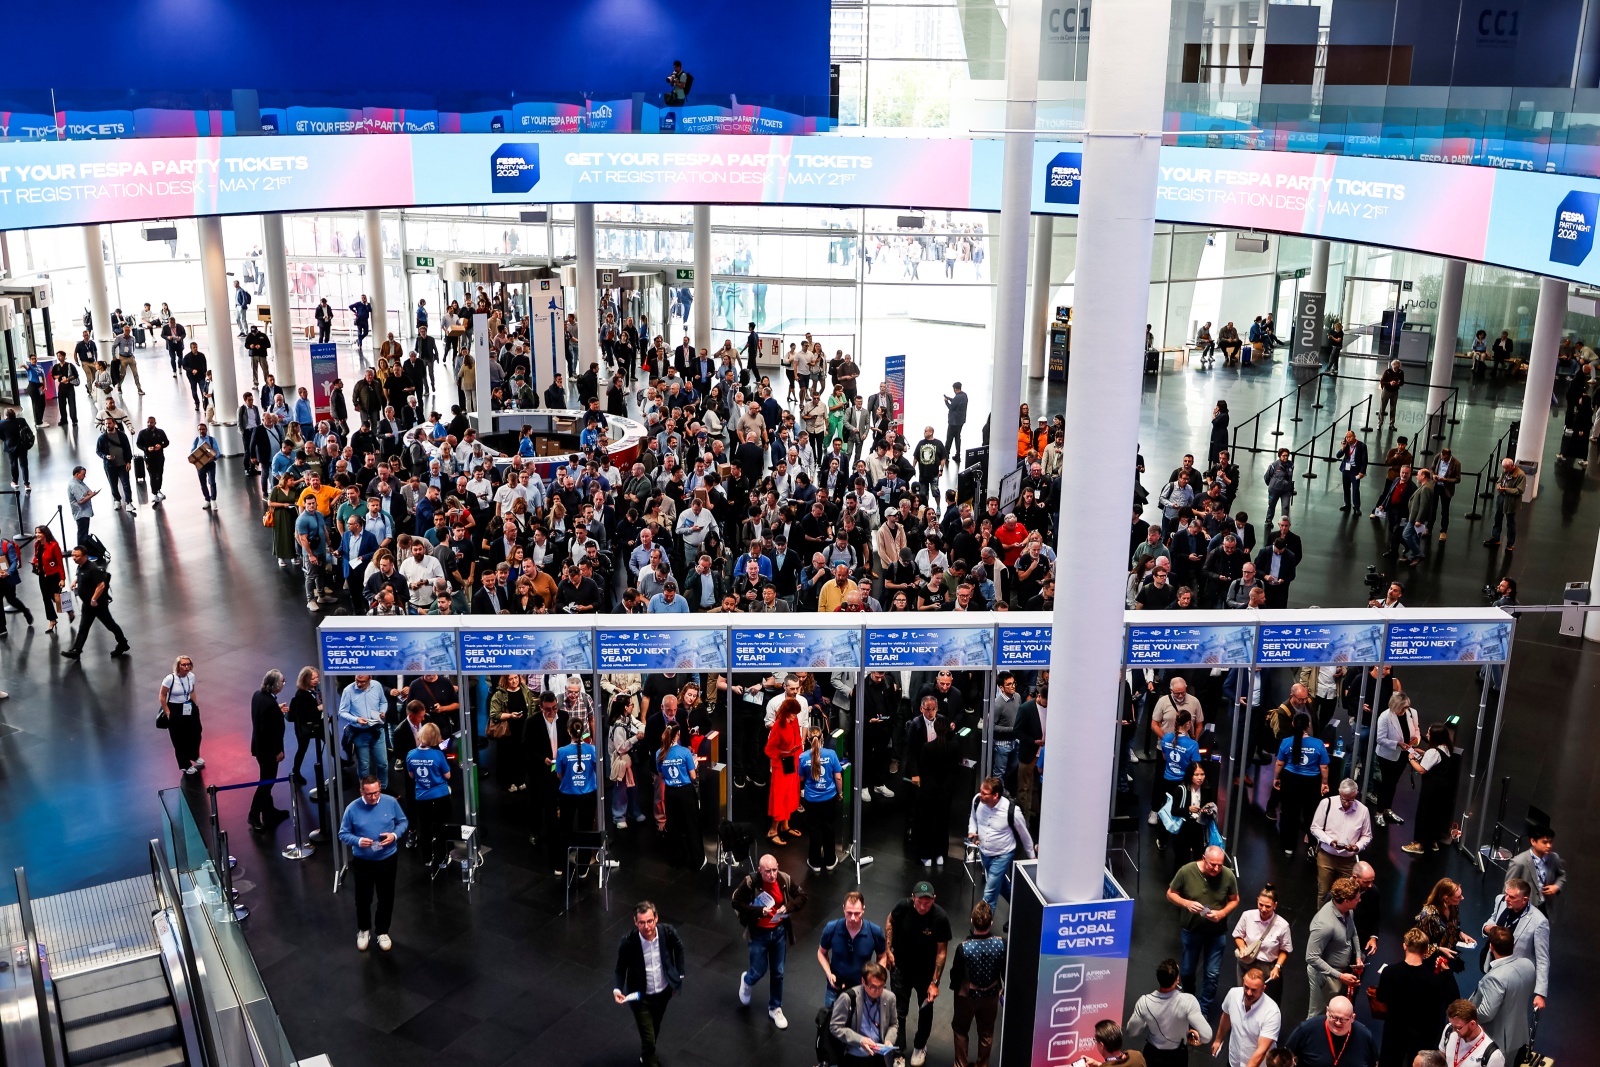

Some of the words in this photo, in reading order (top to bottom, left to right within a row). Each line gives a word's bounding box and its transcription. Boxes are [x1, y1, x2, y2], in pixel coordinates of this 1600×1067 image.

[1049, 8, 1090, 32] CC1
[1478, 9, 1518, 36] CC1
[296, 120, 308, 132] GET
[310, 121, 334, 132] YOUR
[531, 116, 547, 126] YOUR
[548, 116, 566, 126] FESPA
[760, 118, 783, 128] TICKETS
[68, 124, 124, 134] TICKETS
[564, 152, 604, 166] GET
[607, 152, 660, 166] YOUR
[663, 153, 724, 166] FESPA
[728, 154, 791, 167] PARTY
[795, 154, 872, 168] TICKETS
[1488, 156, 1534, 170] TICKETS
[15, 164, 76, 182] YOUR
[80, 162, 148, 179] FESPA
[152, 159, 220, 176] PARTY
[225, 156, 308, 172] TICKETS
[1052, 166, 1080, 174] FESPA
[579, 170, 602, 182] AT
[606, 170, 726, 184] REGISTRATION
[730, 172, 774, 184] DESK
[788, 172, 826, 184] MAY
[1160, 166, 1212, 183] YOUR
[1215, 170, 1272, 187] FESPA
[1276, 174, 1332, 192] PARTY
[1336, 178, 1405, 200] TICKETS
[16, 182, 152, 204] REGISTRATION
[156, 180, 205, 196] DESK
[220, 177, 259, 192] MAY
[1157, 186, 1272, 208] REGISTRATION
[1276, 195, 1315, 212] DESK
[1327, 200, 1361, 217] MAY
[1561, 211, 1585, 224] FESPA
[1559, 221, 1576, 230] PARTY
[1576, 224, 1591, 232] NIGHT
[1558, 228, 1577, 240] 2026
[1407, 299, 1438, 309] nuclo
[1301, 304, 1317, 347] nuclo
[1060, 910, 1116, 924] FUTURE
[1058, 924, 1114, 936] GLOBAL
[1057, 936, 1114, 950] EVENTS
